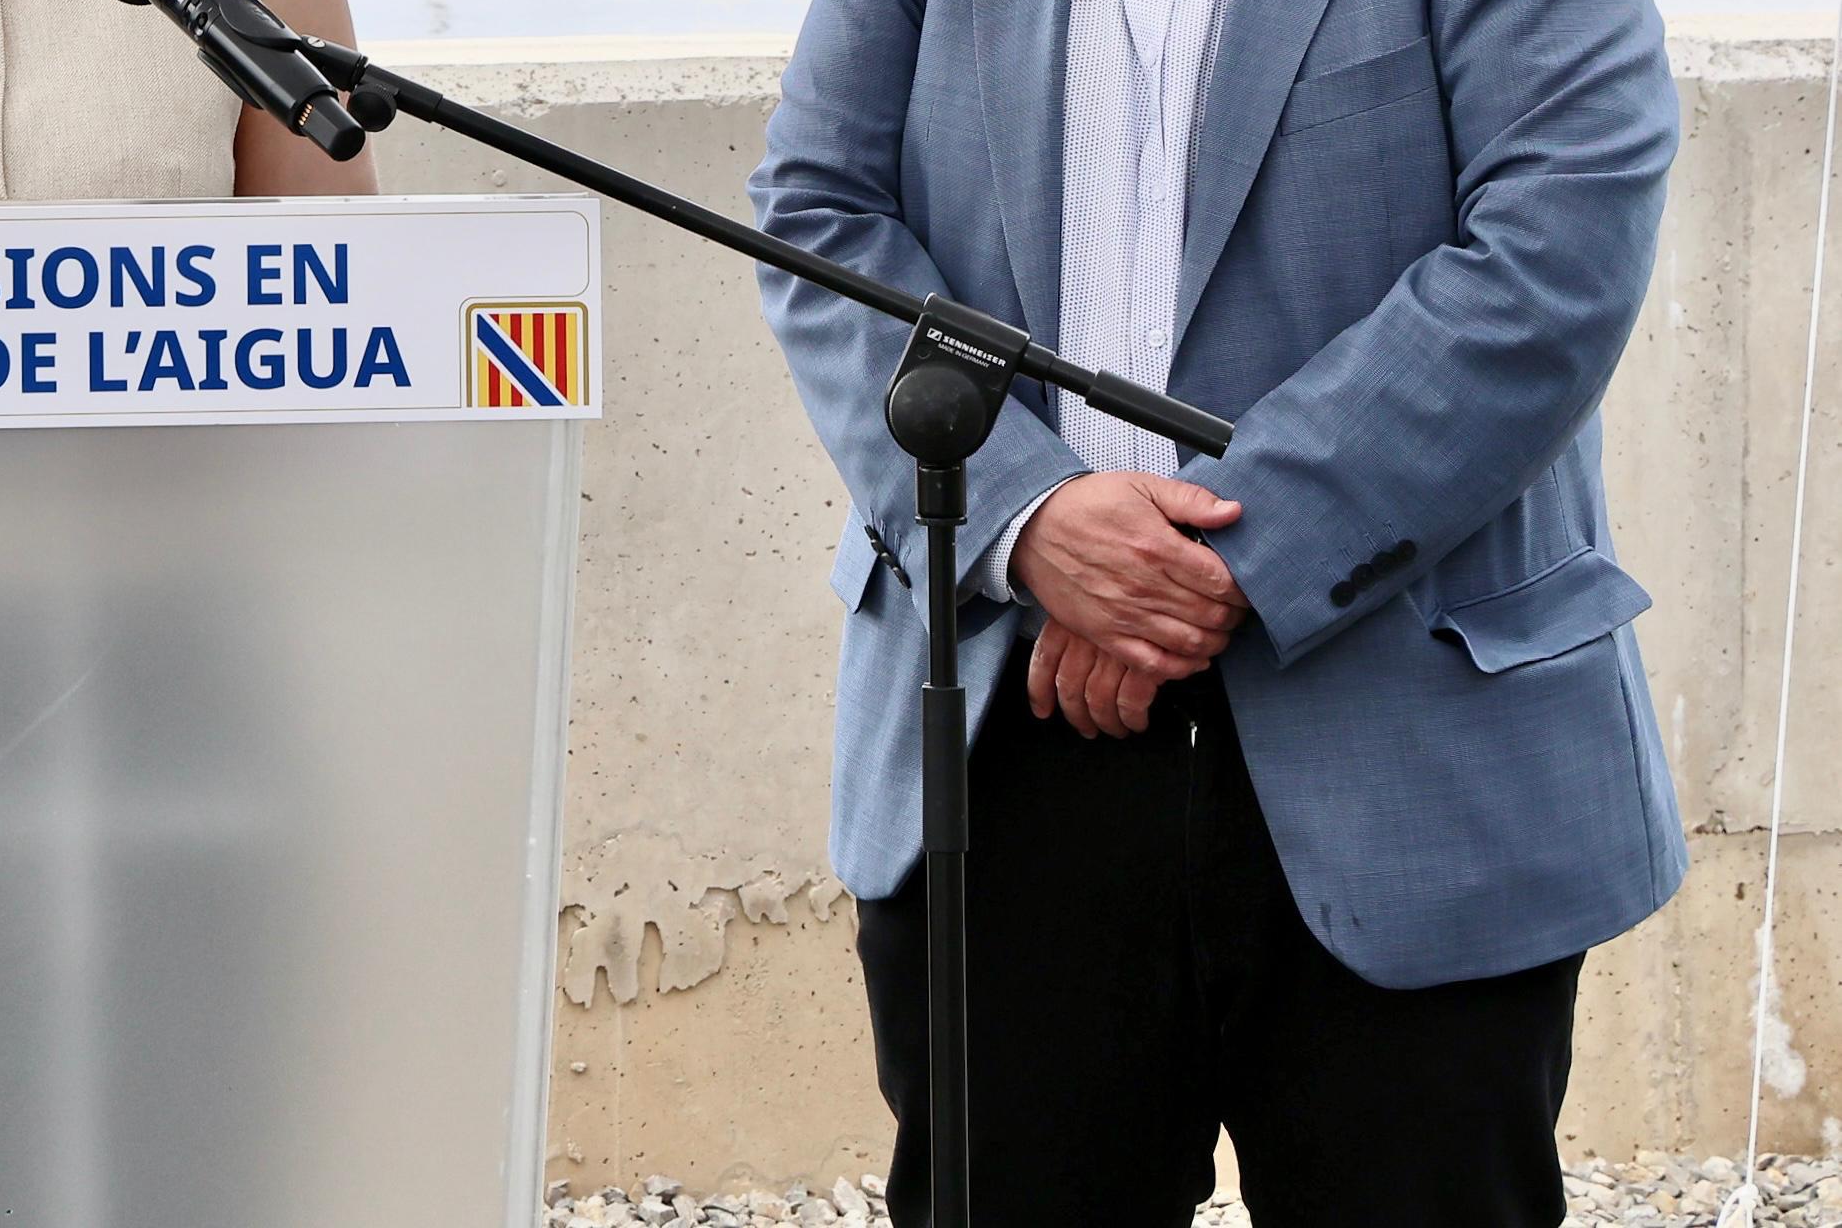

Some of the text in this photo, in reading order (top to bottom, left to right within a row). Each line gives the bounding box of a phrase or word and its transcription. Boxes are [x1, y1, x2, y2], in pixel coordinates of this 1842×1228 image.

[246, 243, 349, 306] EN
[88, 326, 412, 393] L’AIGUA
[942, 335, 1007, 367] SENNHEISER
